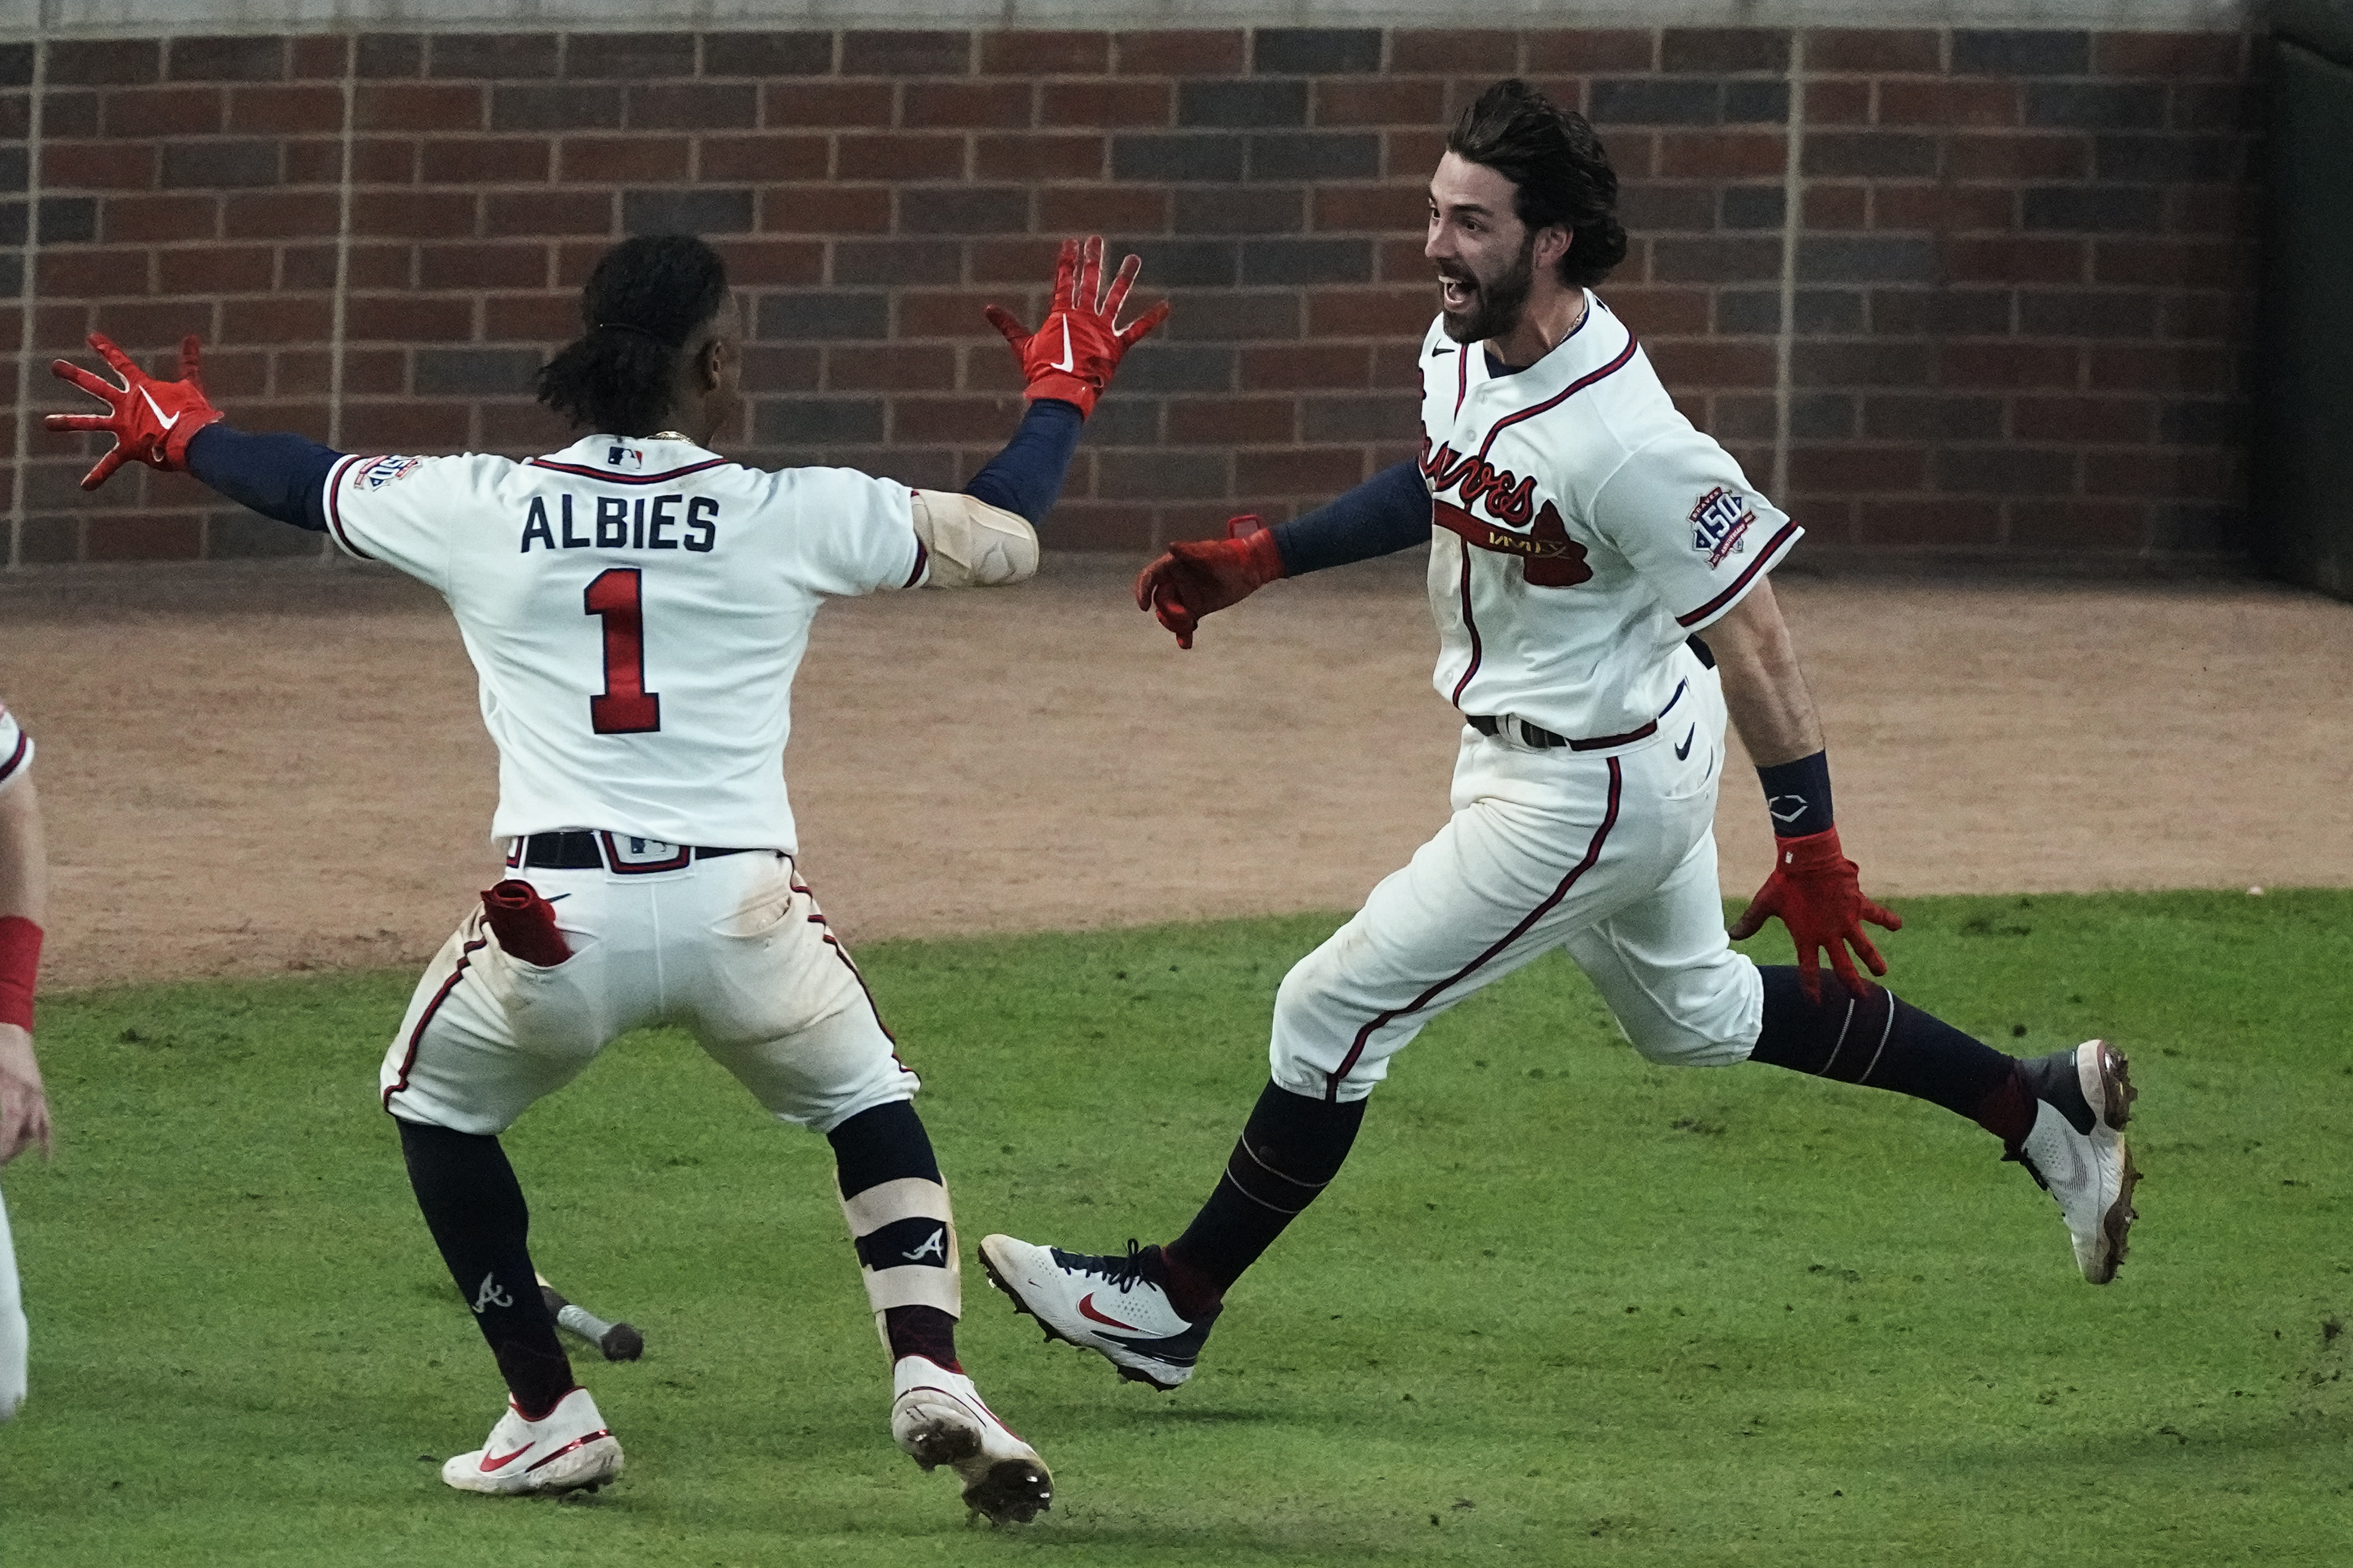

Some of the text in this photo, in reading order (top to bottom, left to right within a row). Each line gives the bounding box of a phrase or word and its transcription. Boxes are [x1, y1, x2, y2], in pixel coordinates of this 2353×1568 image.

[520, 494, 719, 554] ALBIES
[1693, 493, 1742, 551] 150
[583, 567, 661, 735] 1
